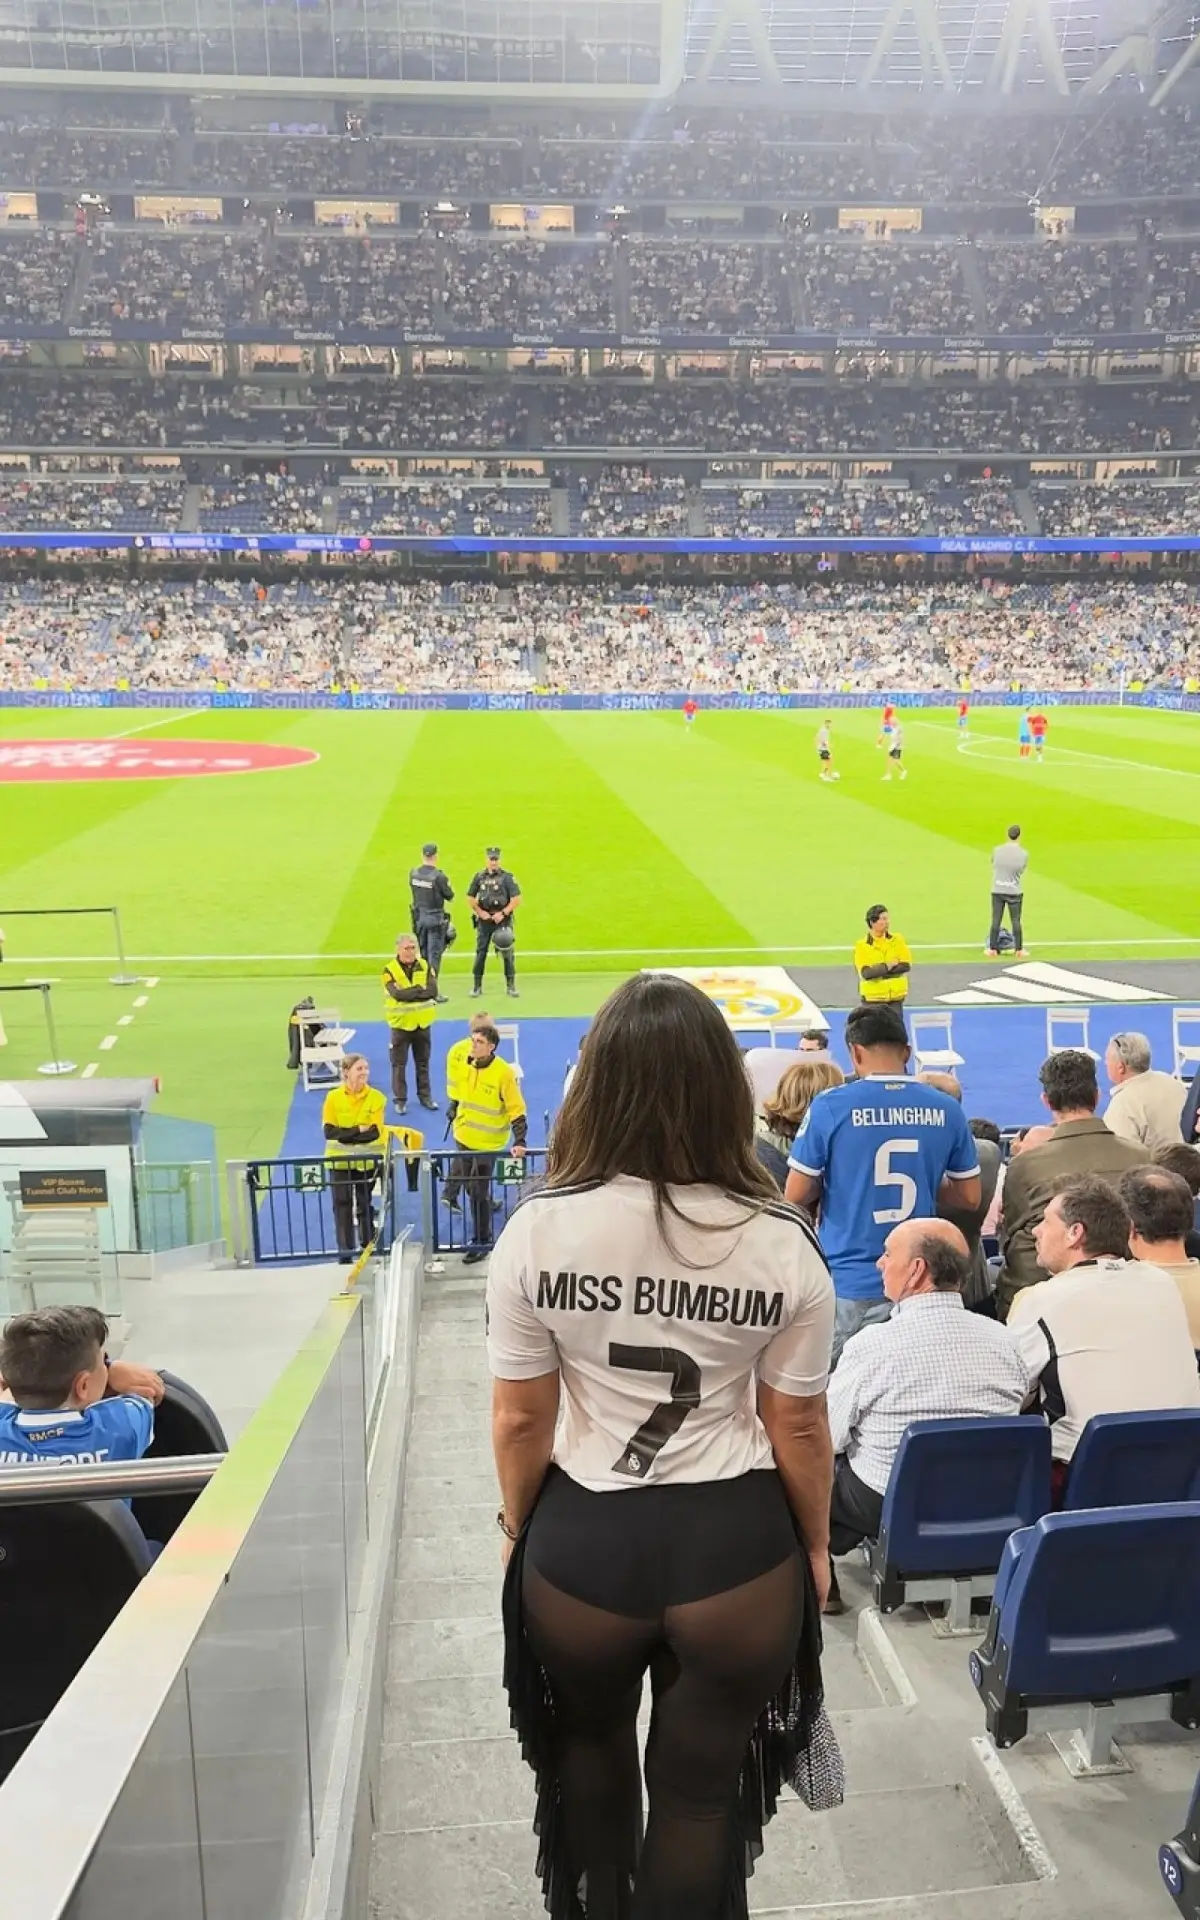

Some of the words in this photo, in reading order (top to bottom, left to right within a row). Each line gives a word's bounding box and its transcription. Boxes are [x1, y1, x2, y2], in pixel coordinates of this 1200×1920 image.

[941, 540, 968, 552] REAL
[970, 540, 1013, 552] MADRID
[135, 690, 211, 708] Sanitas
[262, 692, 337, 708] Sanitas
[930, 692, 1003, 707] Saitas
[851, 1107, 945, 1127] BELLINGHAM
[41, 1178, 57, 1186] VIP
[58, 1178, 85, 1186] Boxes
[872, 1139, 919, 1224] 5
[25, 1187, 55, 1196] Tunnel
[56, 1187, 77, 1195] Club
[536, 1270, 623, 1312] MISS
[633, 1276, 784, 1327] BUMBUM
[608, 1342, 701, 1478] 7
[28, 1427, 65, 1441] RMCF
[1163, 1857, 1177, 1886] 12
